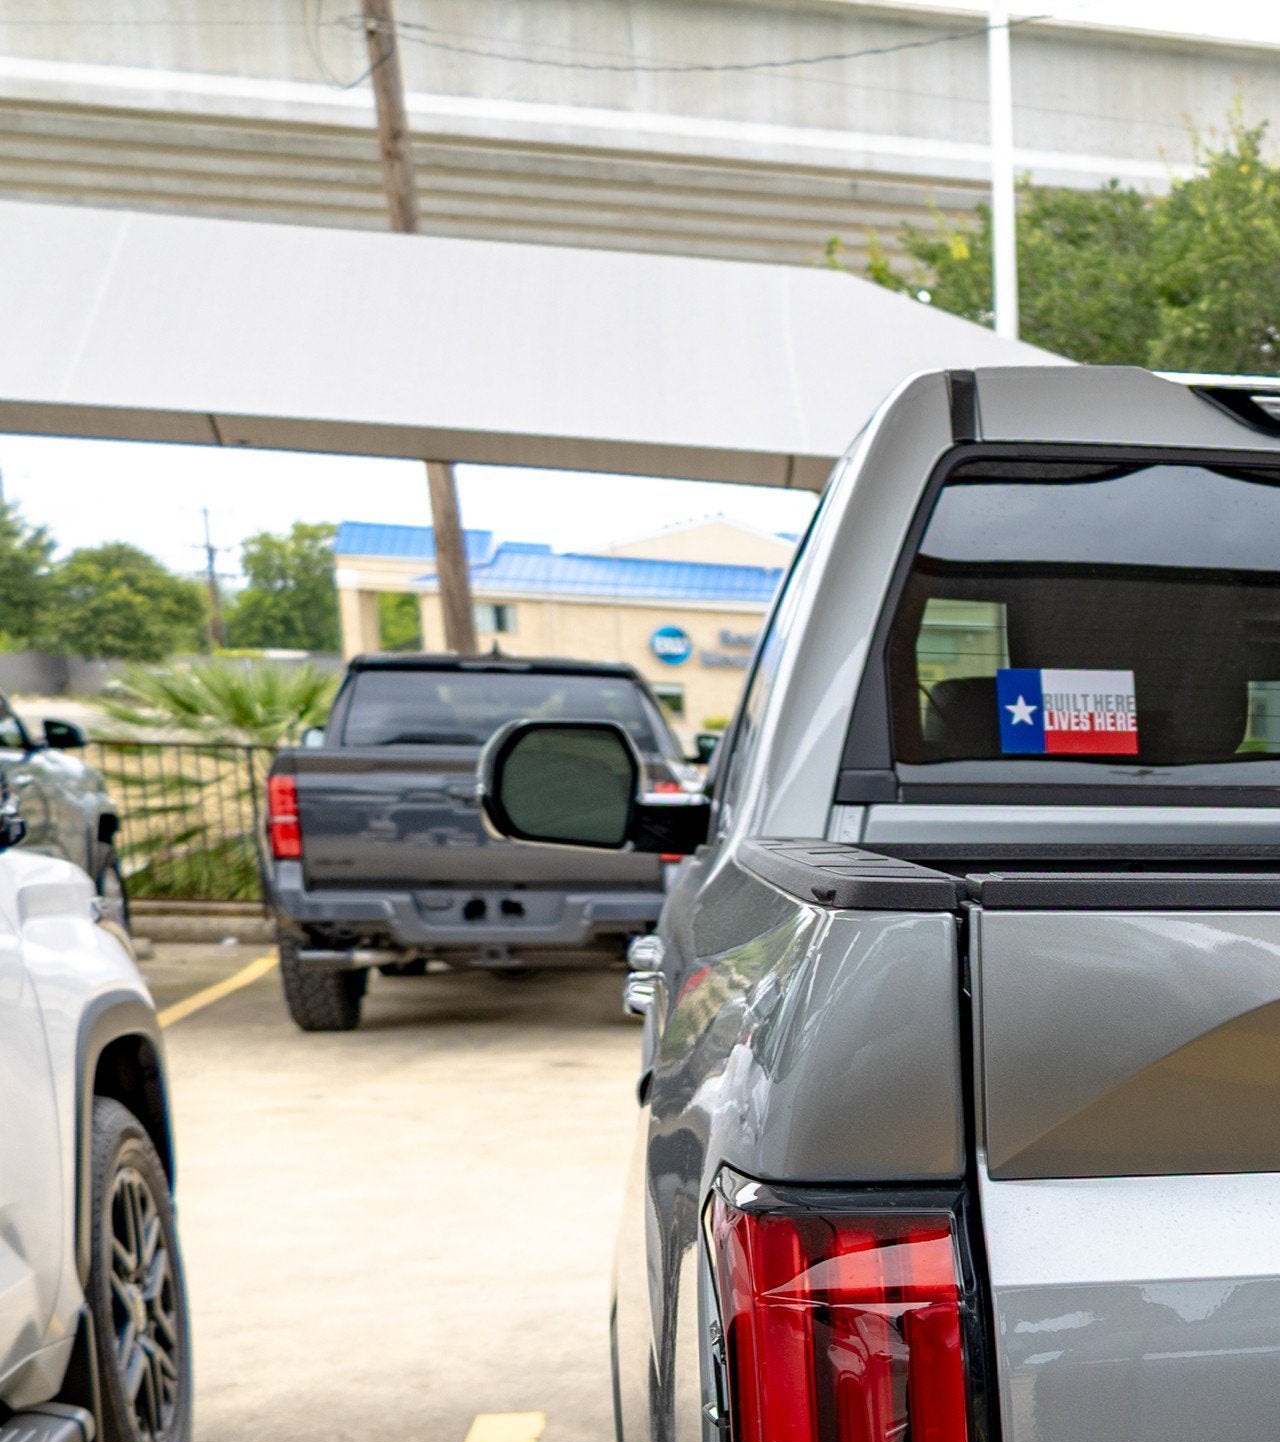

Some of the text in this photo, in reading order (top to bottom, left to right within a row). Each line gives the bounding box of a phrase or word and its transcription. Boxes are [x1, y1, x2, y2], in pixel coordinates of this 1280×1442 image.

[1043, 693, 1135, 713] BUILT HERE
[1044, 711, 1138, 732] LIVES HERE
